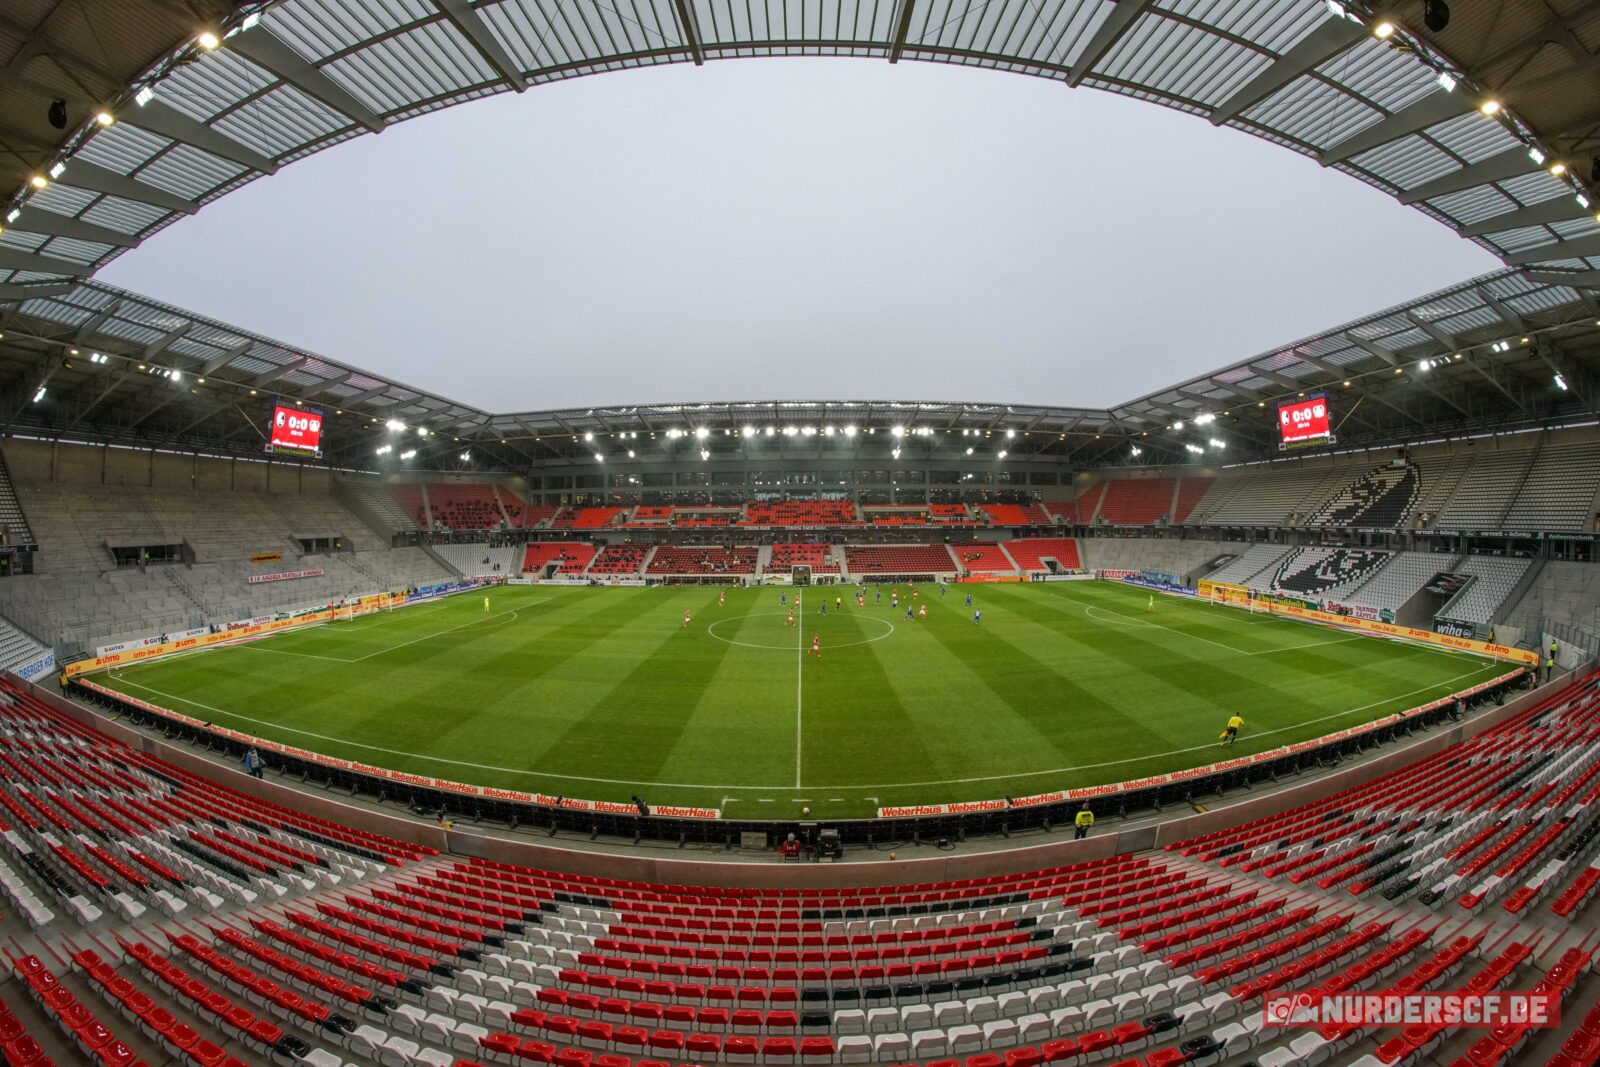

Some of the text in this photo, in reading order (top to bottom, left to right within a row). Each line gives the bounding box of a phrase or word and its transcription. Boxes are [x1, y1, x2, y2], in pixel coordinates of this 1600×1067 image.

[1293, 408, 1312, 422] 0:0
[288, 416, 308, 430] 0:0
[1415, 629, 1431, 638] LOTTO
[1437, 623, 1463, 637] wiha
[181, 638, 198, 647] LOTTO
[352, 761, 388, 777] WeberHaus
[1214, 757, 1252, 772] WeberHaus
[391, 770, 431, 786] WeberHaus
[1170, 767, 1212, 782] WeberHaus
[435, 779, 479, 795] WeberHaus
[1122, 775, 1168, 791] WeberHaus
[483, 786, 532, 802] WeberHaus
[1068, 784, 1119, 799] WeberHaus
[947, 800, 1005, 814] WeberHaus
[1012, 792, 1064, 808] WeberHaus
[656, 806, 717, 819] WeberHaus
[881, 805, 942, 817] WeberHaus
